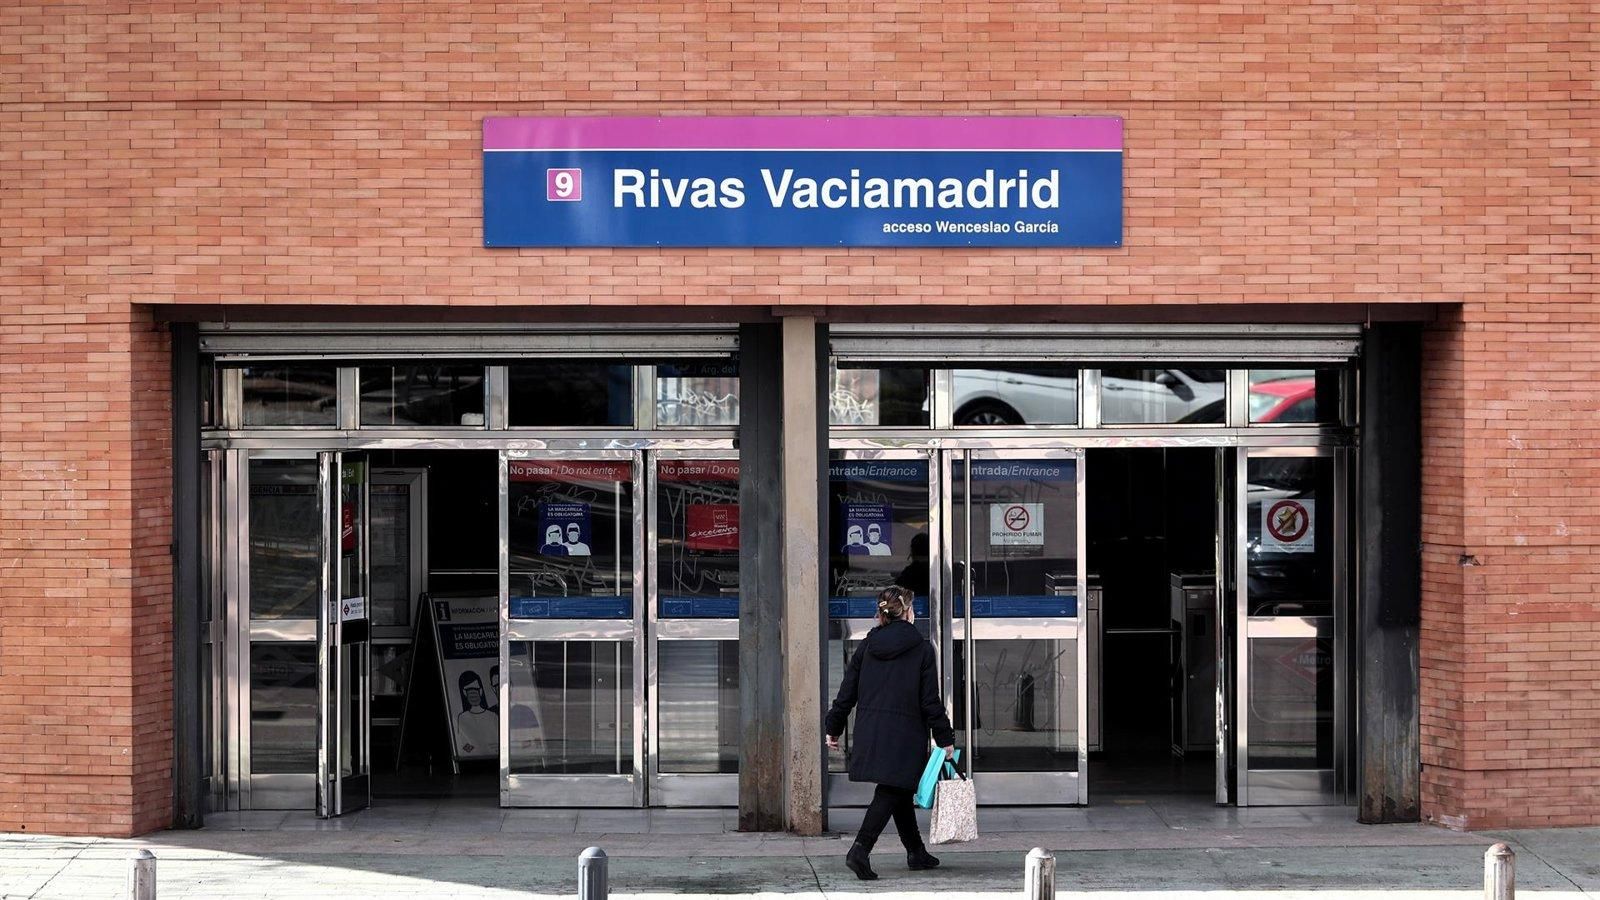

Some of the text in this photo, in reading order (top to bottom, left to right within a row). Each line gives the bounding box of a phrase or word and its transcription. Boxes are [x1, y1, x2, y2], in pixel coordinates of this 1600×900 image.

[555, 169, 1059, 209] 9 Rivas Vaciamadrid
[883, 220, 1059, 233] acceso Wenceslao García
[509, 466, 523, 475] No
[526, 467, 554, 476] pasar
[560, 466, 575, 475] Do
[576, 467, 592, 475] not
[592, 467, 617, 475] enter
[661, 466, 675, 474] No
[677, 466, 705, 476] pasar
[711, 466, 726, 474] Do
[454, 632, 463, 641] LA
[455, 642, 464, 650] ES
